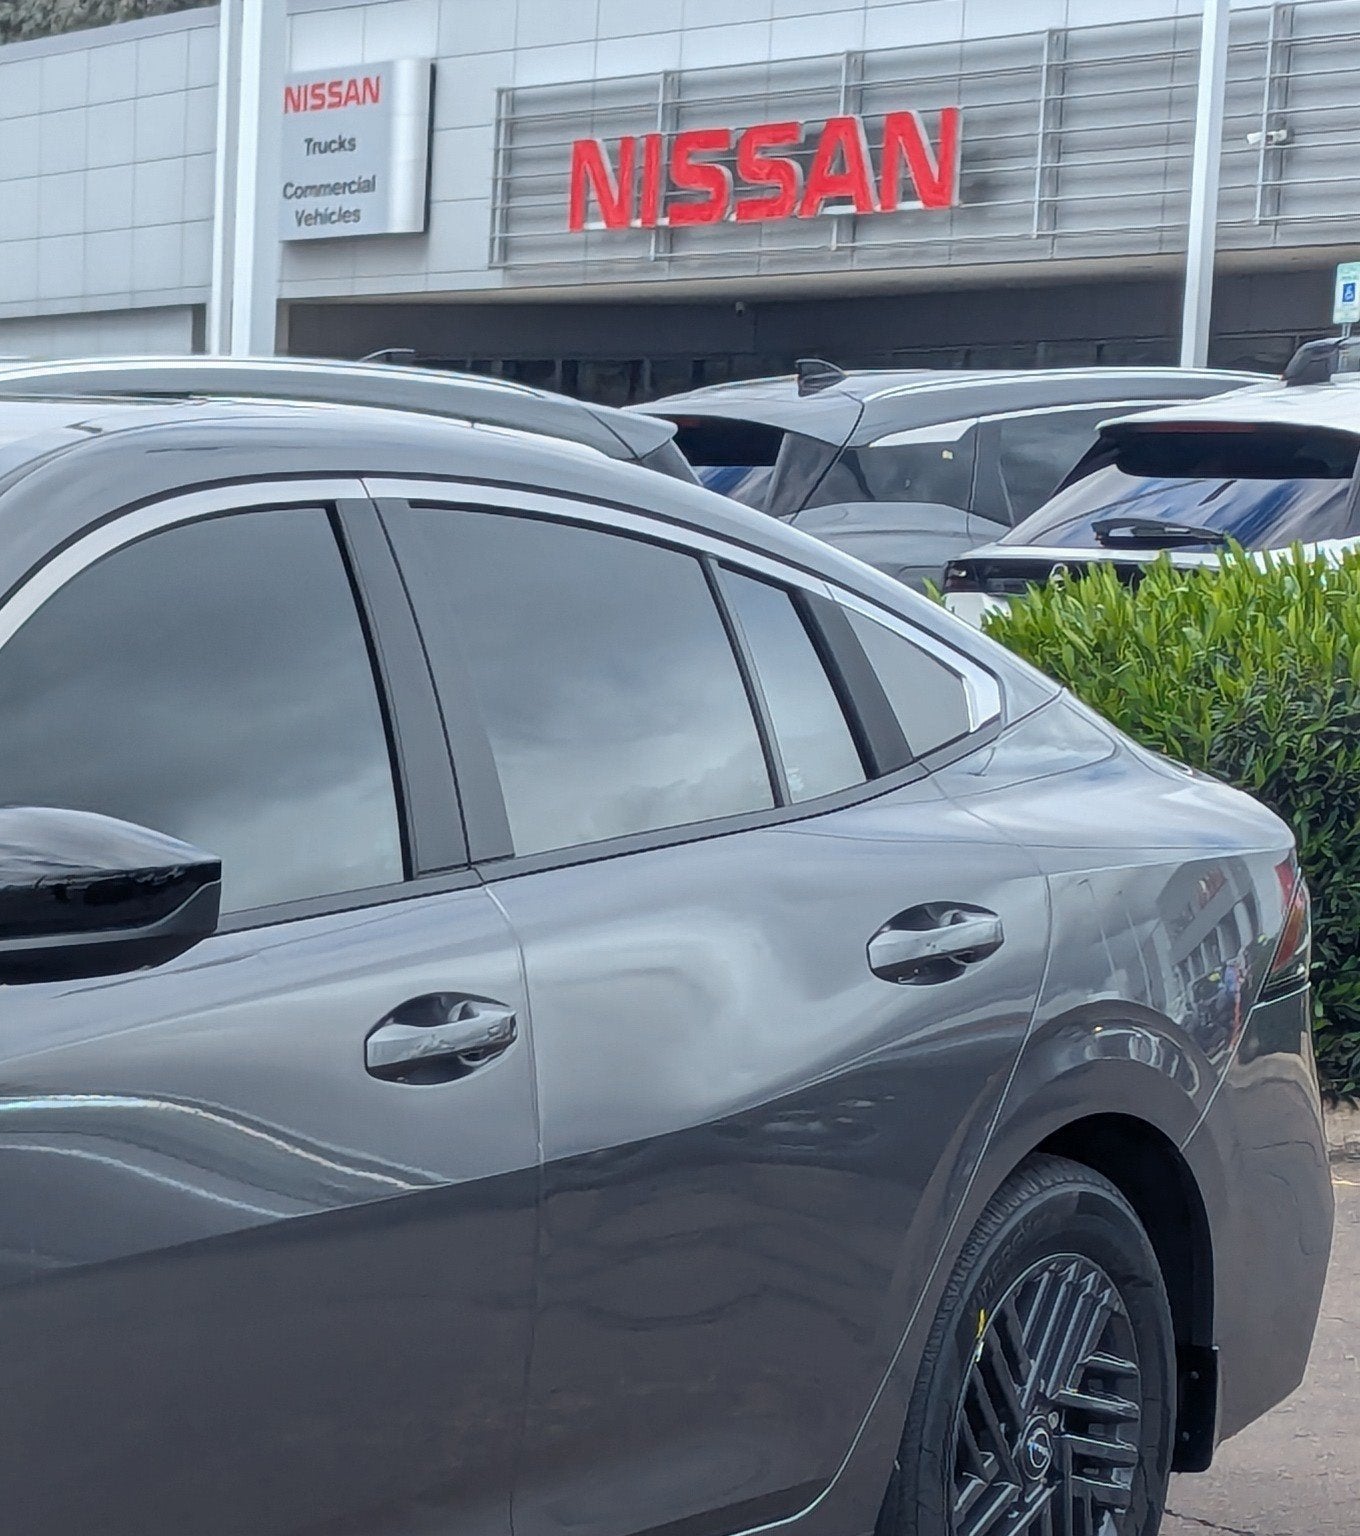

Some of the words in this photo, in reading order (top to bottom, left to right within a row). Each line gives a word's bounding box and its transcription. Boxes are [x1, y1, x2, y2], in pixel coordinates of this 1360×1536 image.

[283, 76, 382, 114] NISSAN
[304, 135, 356, 156] Trucks
[568, 107, 962, 231] NISSAN
[283, 175, 376, 200] Commercial
[295, 206, 361, 227] Vehicles
